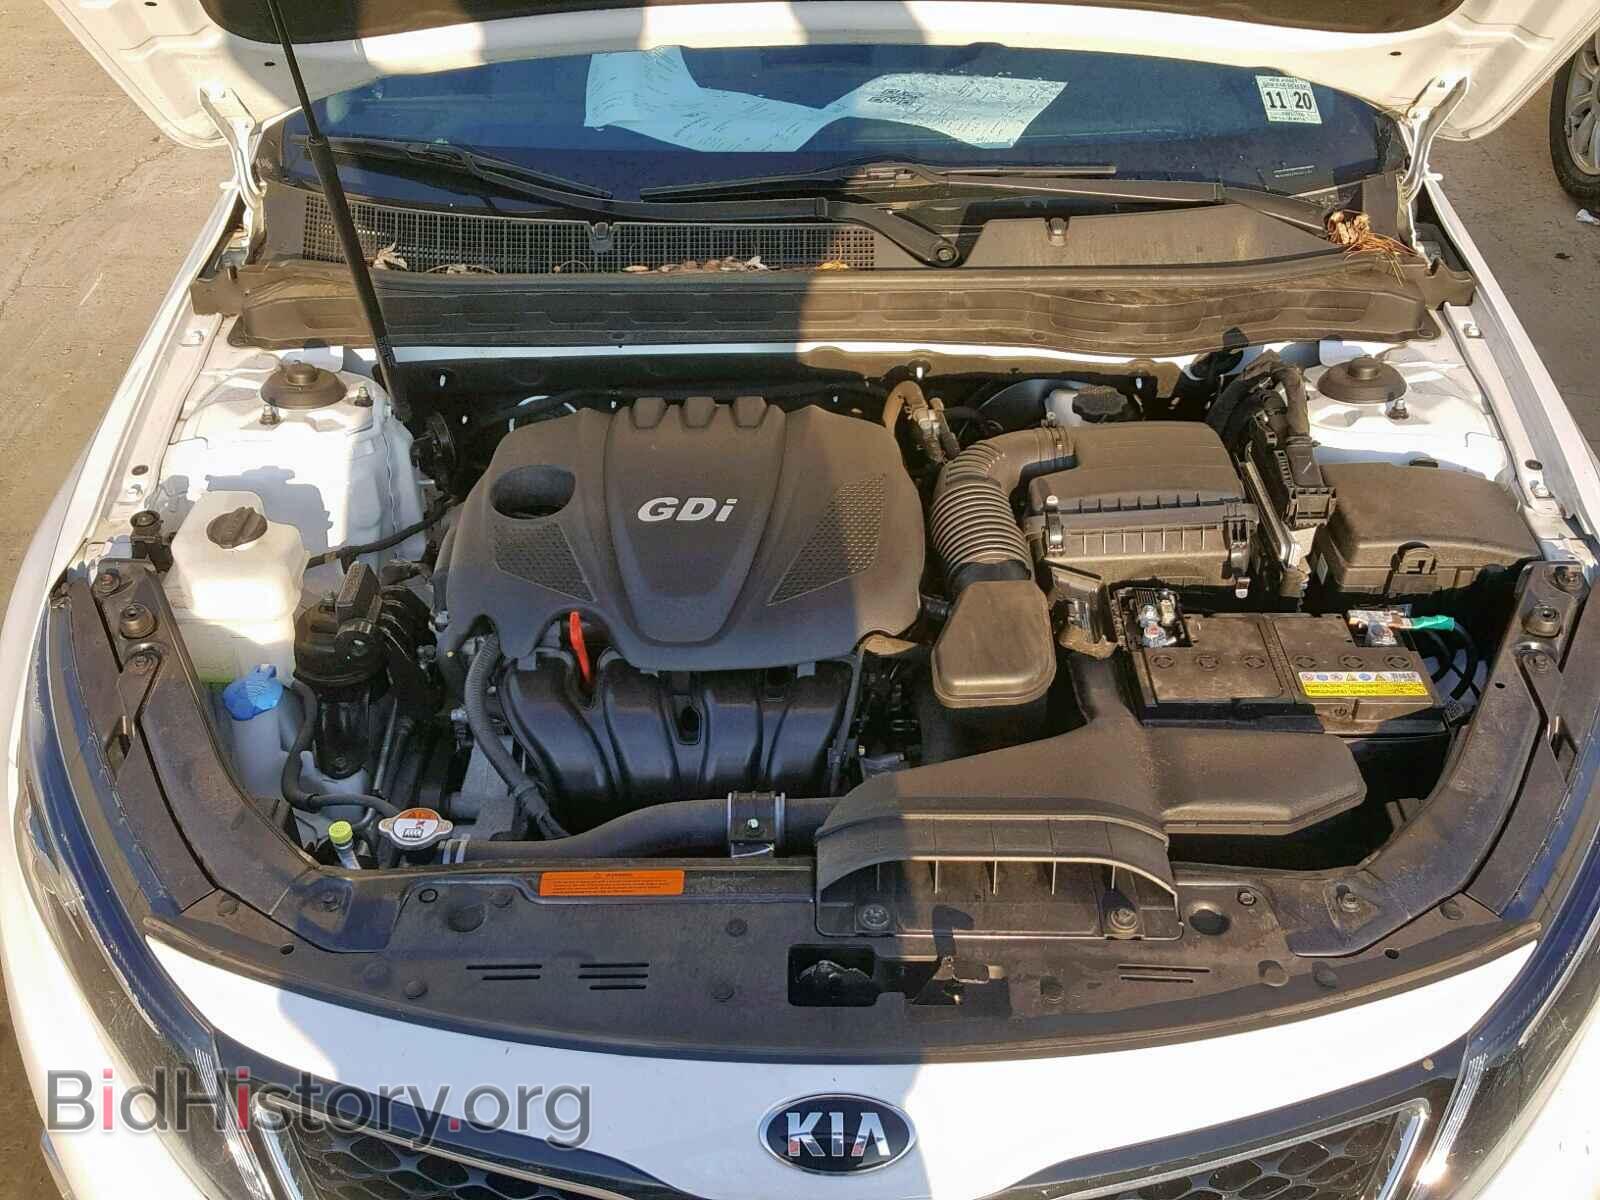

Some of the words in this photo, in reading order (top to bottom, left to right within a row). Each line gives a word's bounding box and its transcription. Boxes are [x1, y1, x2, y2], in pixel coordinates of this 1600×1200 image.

[1265, 91, 1287, 109] 11
[1293, 91, 1313, 110] 20
[637, 496, 739, 523] GDi
[785, 1112, 891, 1157] KIA
